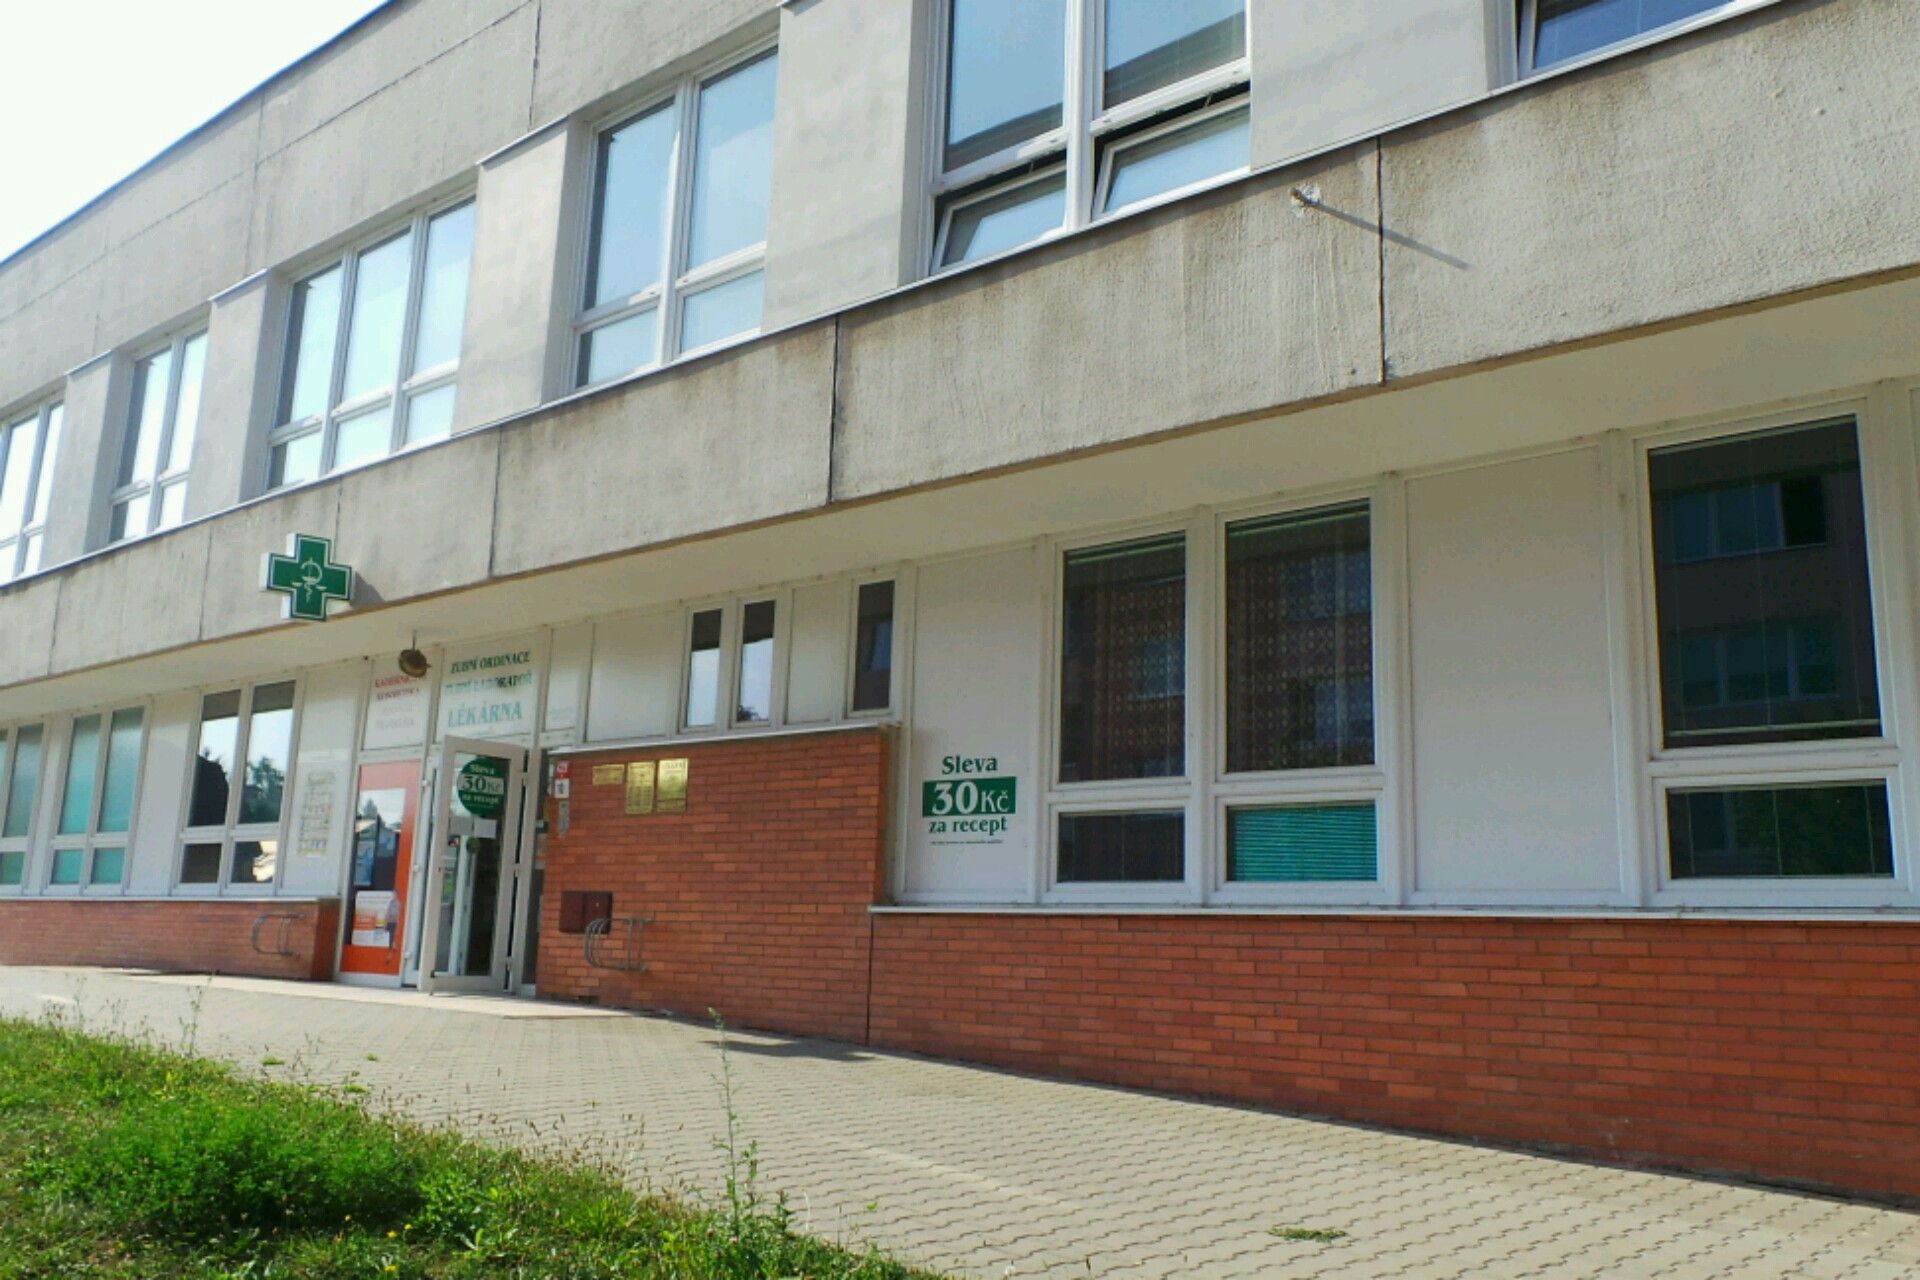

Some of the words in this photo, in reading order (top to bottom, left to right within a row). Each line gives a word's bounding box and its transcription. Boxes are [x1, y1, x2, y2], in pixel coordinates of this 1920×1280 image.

[479, 651, 530, 669] ORDINACE
[448, 701, 522, 728] LÉKÁRNA
[941, 755, 999, 774] Sleva
[929, 821, 947, 834] za
[952, 816, 1008, 836] recept
